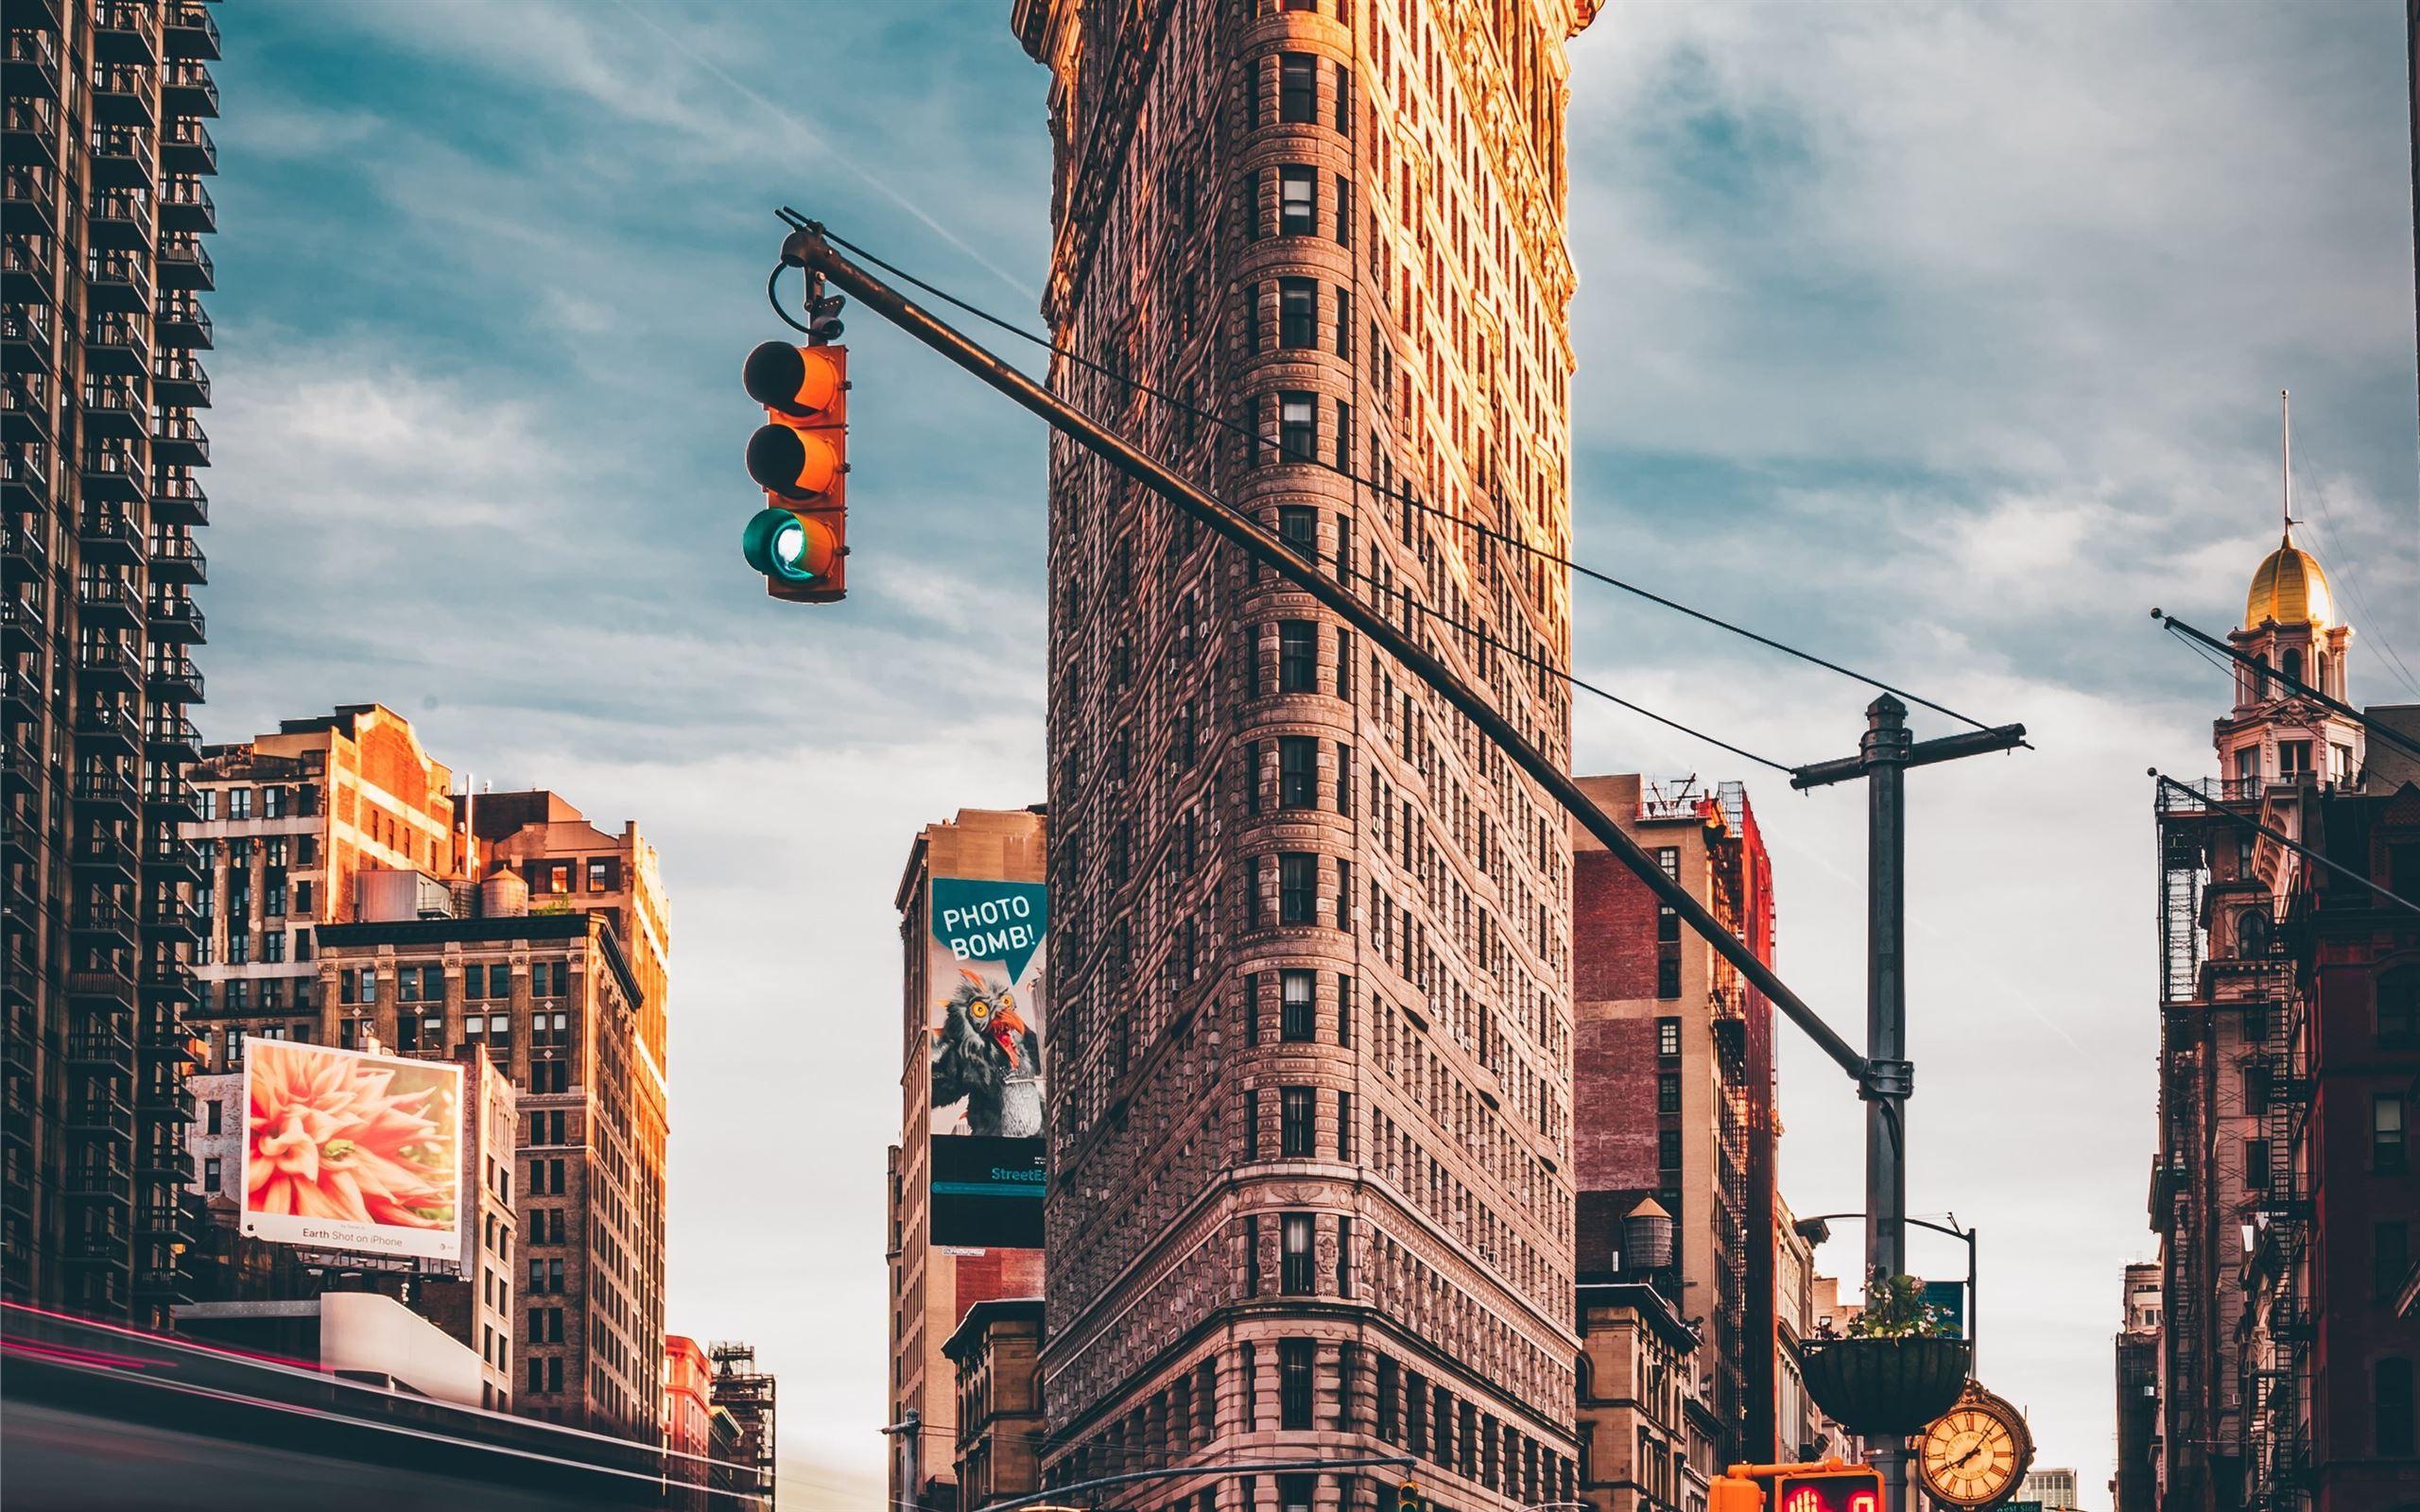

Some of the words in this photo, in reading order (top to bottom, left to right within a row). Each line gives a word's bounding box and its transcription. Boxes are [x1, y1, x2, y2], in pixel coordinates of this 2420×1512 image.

[943, 896, 1029, 932] PHOTO
[950, 924, 1036, 961] BOMB!
[302, 1228, 330, 1239] Earth
[332, 1231, 354, 1242] Shot
[371, 1235, 403, 1247] iPhone
